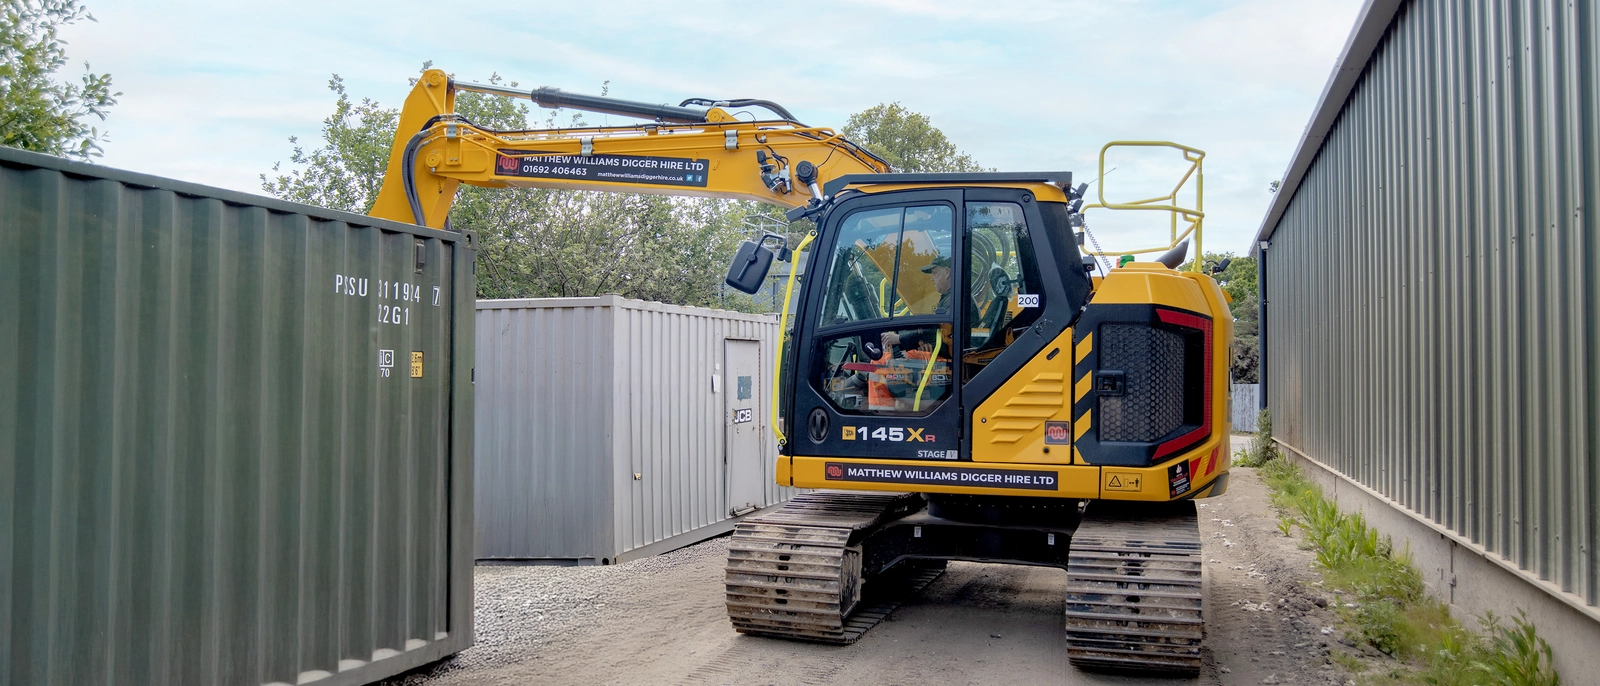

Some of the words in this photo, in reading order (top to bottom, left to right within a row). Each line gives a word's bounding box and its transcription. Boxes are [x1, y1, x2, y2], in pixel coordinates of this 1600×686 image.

[523, 155, 572, 164] MATTHEW
[573, 157, 620, 167] WILLIAMS
[622, 159, 658, 169] DIGGER
[660, 161, 684, 170] HIRE
[685, 162, 704, 171] LTD
[522, 165, 550, 174] 01692
[552, 166, 588, 176] 406463
[597, 172, 684, 182] matthewwilliamsdiggerhire.co.uk
[335, 274, 368, 297] PSSU
[378, 279, 421, 303] 311924
[1018, 296, 1039, 305] 200
[378, 304, 409, 325] 22G1
[380, 368, 390, 378] 70
[734, 409, 752, 423] JCB
[917, 450, 945, 459] STAGE
[848, 468, 903, 478] MATTHEW
[904, 469, 958, 481] WILLIAMS
[960, 472, 1002, 483] DIGGER
[1004, 474, 1031, 484] HIRE
[1033, 475, 1054, 485] LTD
